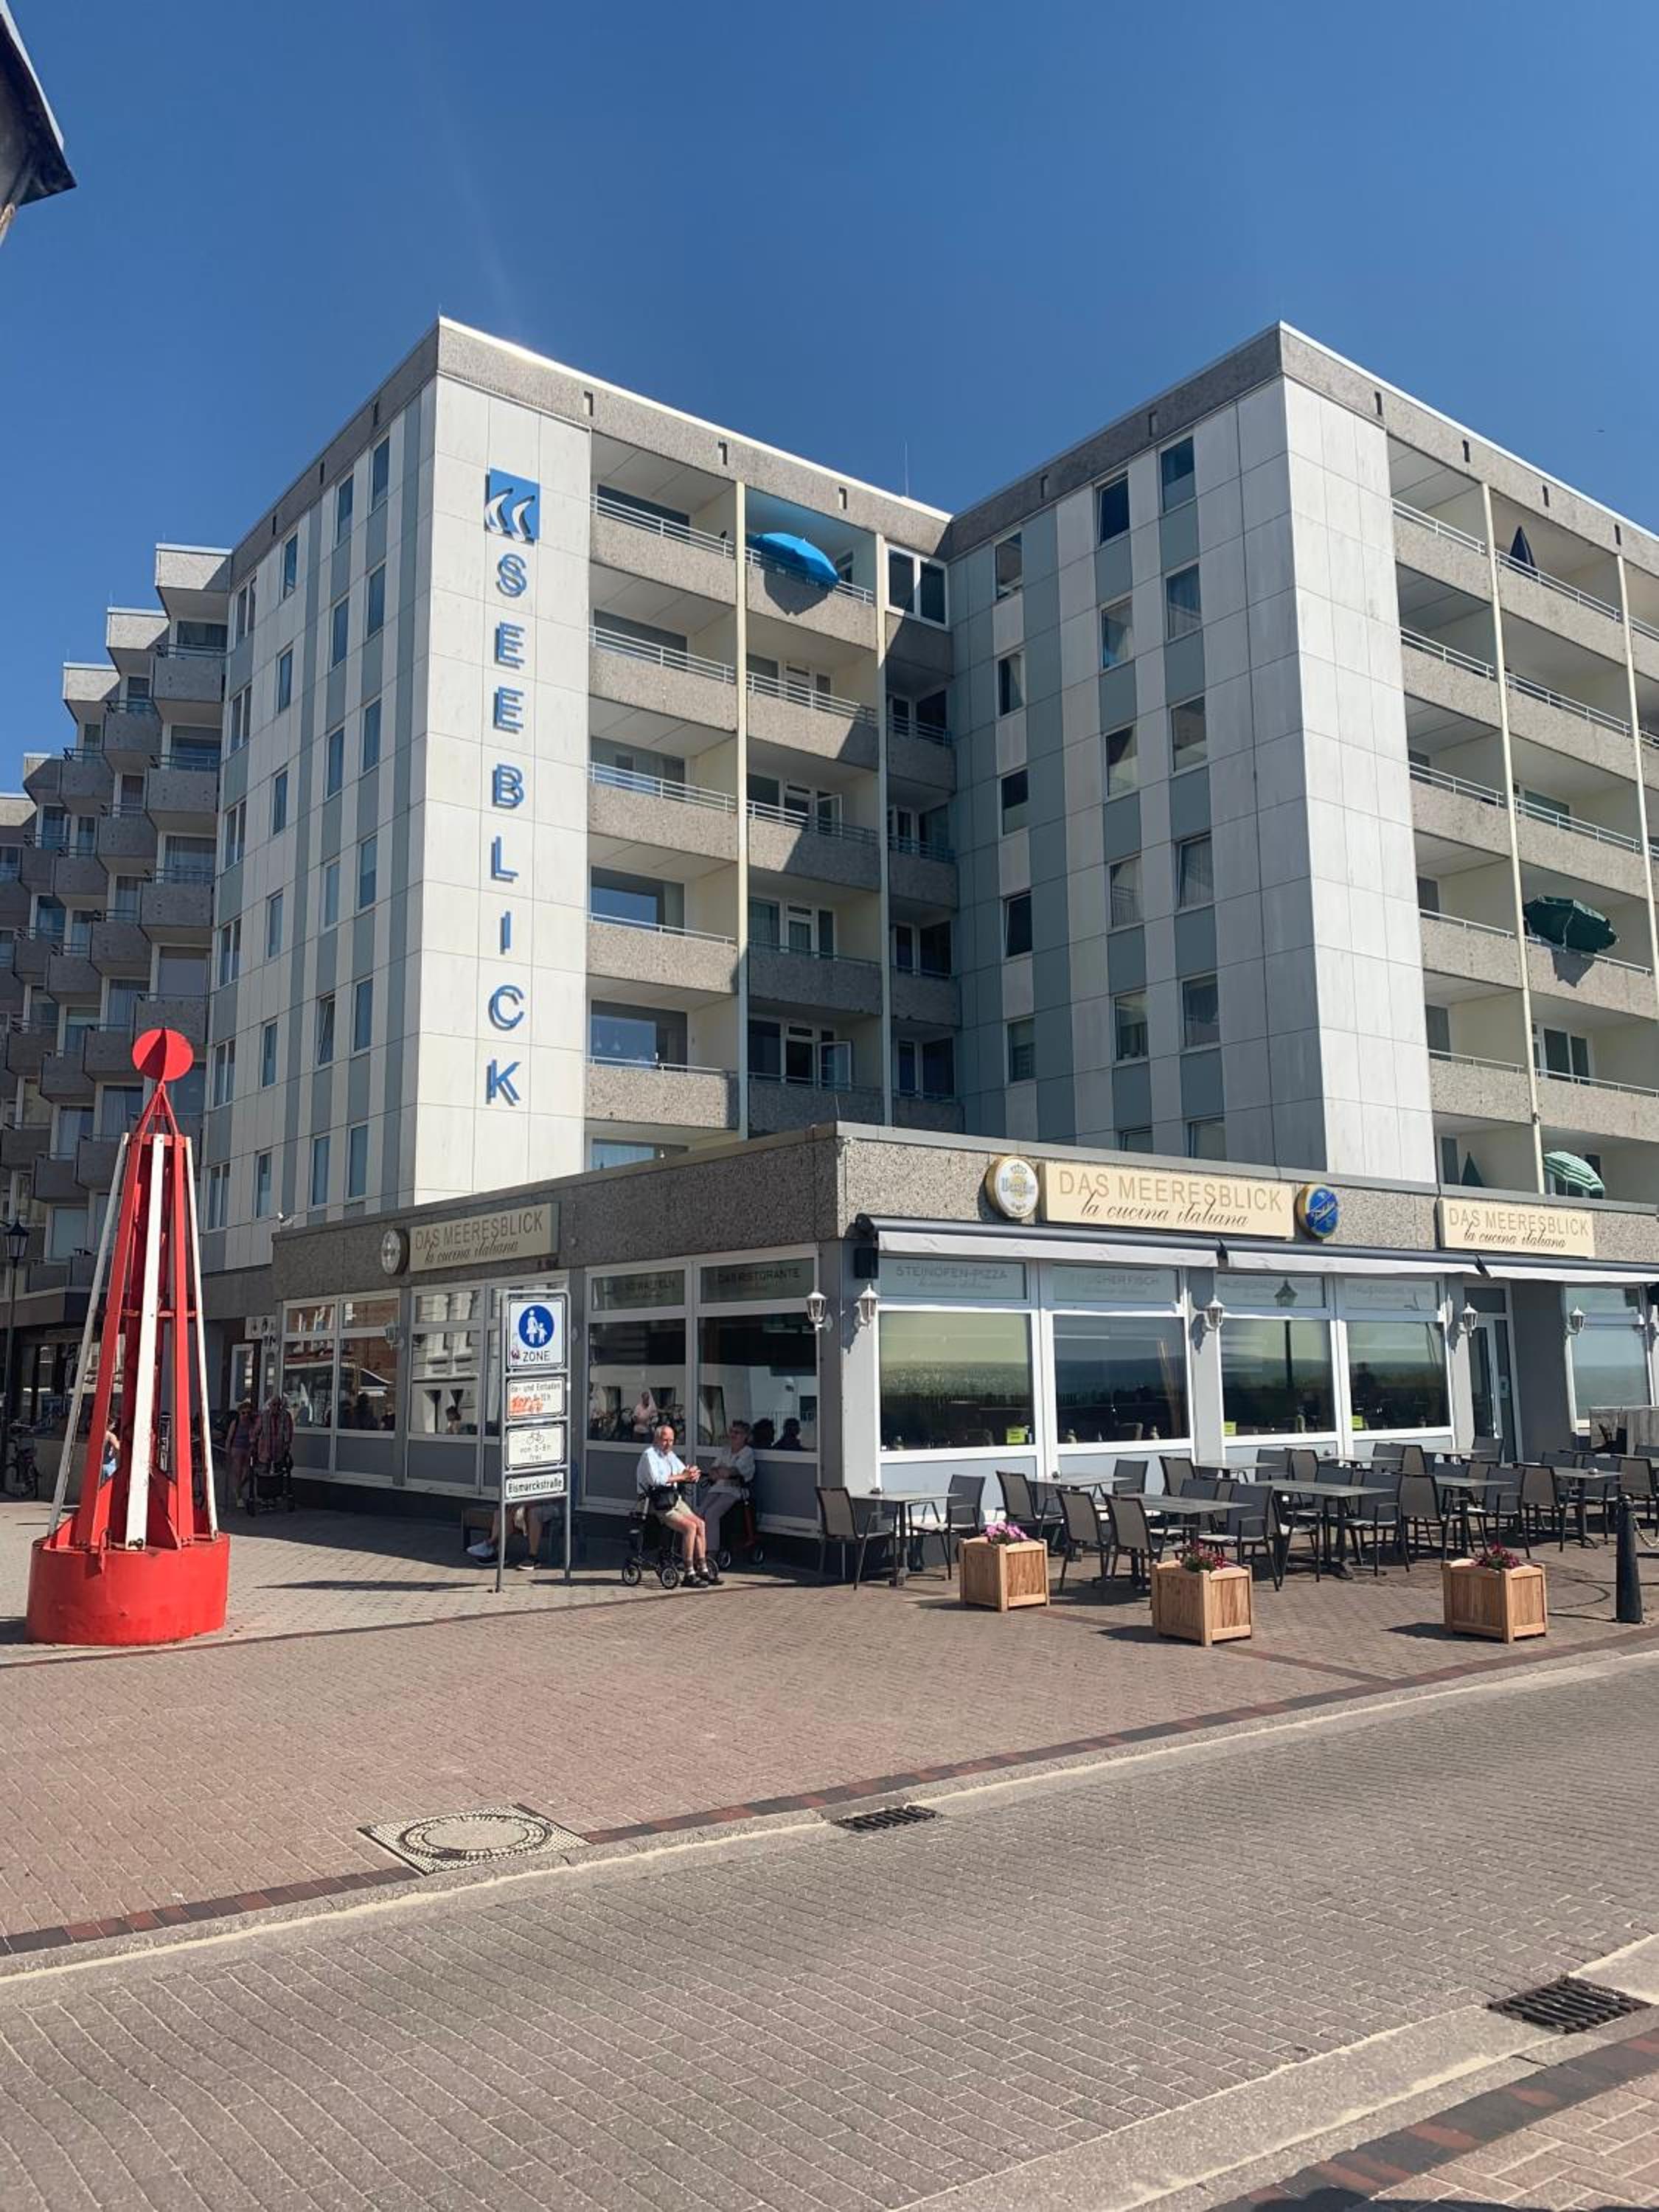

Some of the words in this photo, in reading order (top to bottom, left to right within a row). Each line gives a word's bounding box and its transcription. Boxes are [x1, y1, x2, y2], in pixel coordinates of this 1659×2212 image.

[487, 553, 527, 1105] SEEBLICK
[1059, 1170, 1109, 1197] DAS
[1118, 1175, 1284, 1213] MEERESBLICK
[1080, 1189, 1098, 1217] la
[1107, 1202, 1170, 1222] cucina
[1177, 1197, 1250, 1228] italiana
[414, 1228, 440, 1251] DAS
[443, 1210, 543, 1246] MEERESBLICK
[1448, 1207, 1481, 1228] DAS
[1486, 1211, 1590, 1237] MEERESBLICK
[1464, 1221, 1476, 1242] la
[1478, 1230, 1517, 1245] cucina
[1521, 1226, 1566, 1248] italiana
[522, 1350, 551, 1363] ZONE
[508, 1477, 562, 1493] Bismarckstraße
